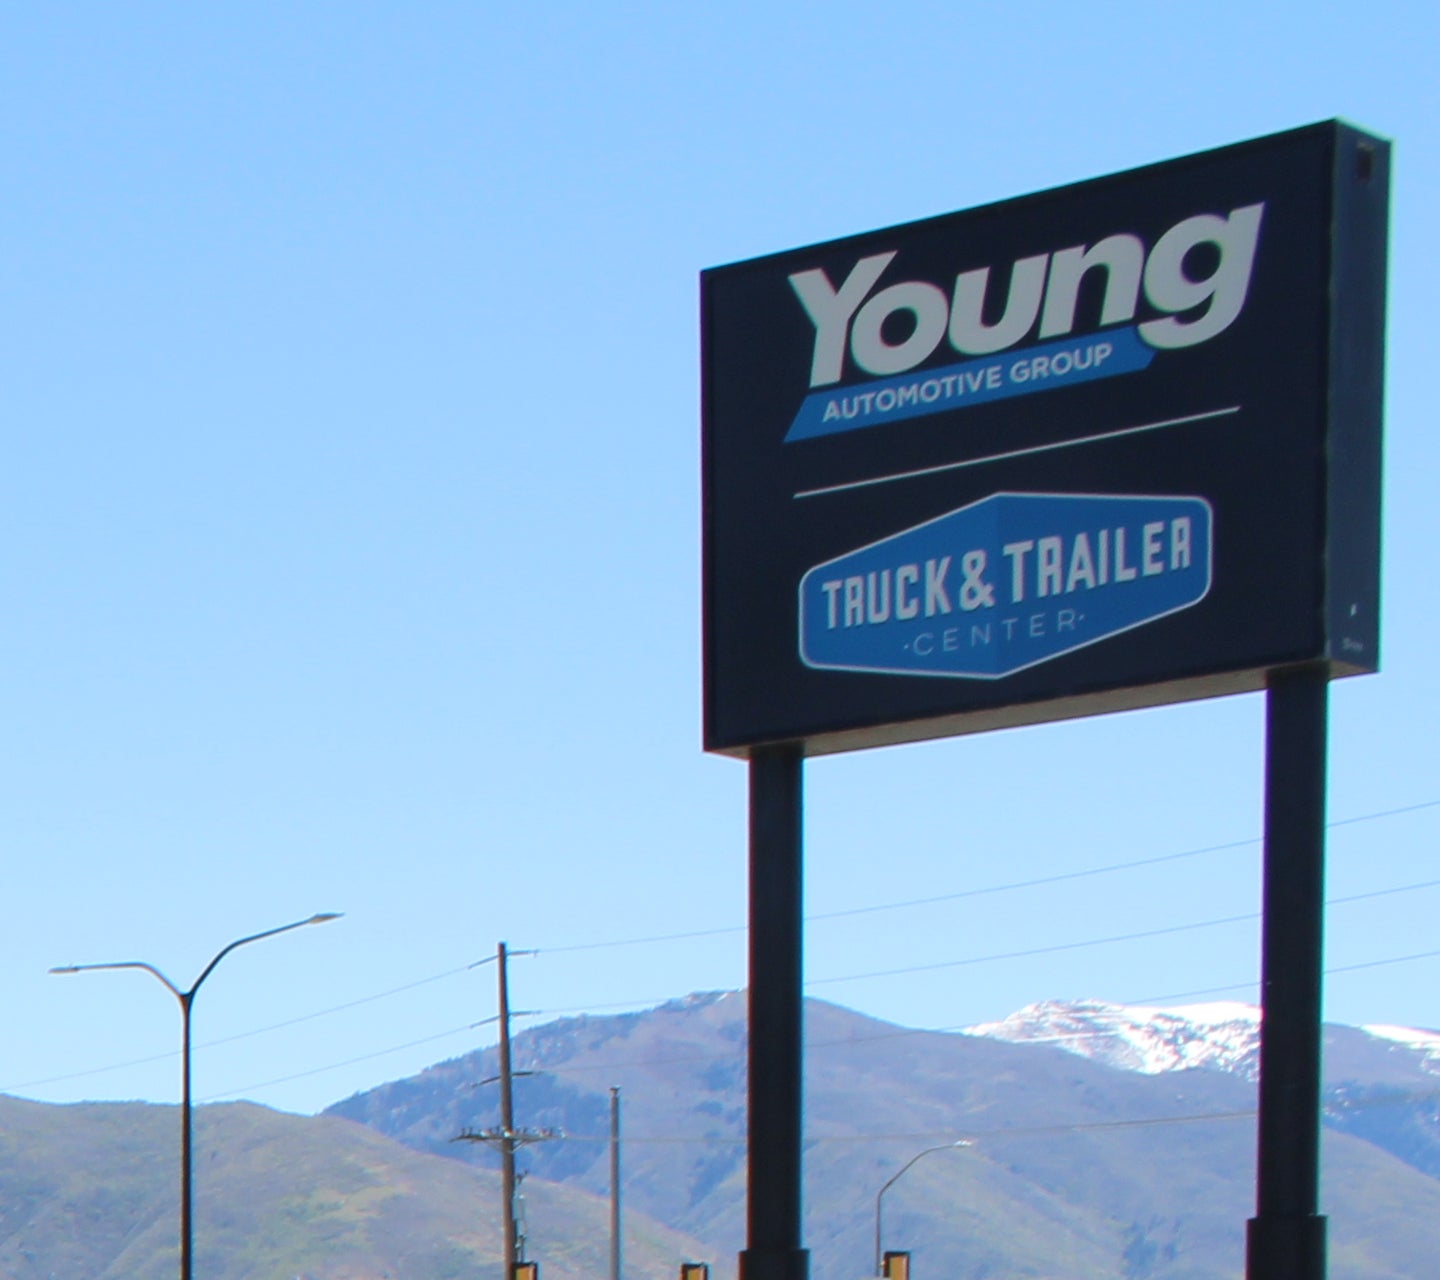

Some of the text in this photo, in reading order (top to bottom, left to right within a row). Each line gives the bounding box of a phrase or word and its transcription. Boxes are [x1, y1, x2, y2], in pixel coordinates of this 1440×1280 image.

[788, 201, 1266, 389] Young
[822, 343, 1114, 423] AUTOMOTIVE GROUP
[820, 556, 953, 630] TRUCK
[1002, 516, 1192, 605] TRAILER
[912, 608, 1078, 657] CENTER
